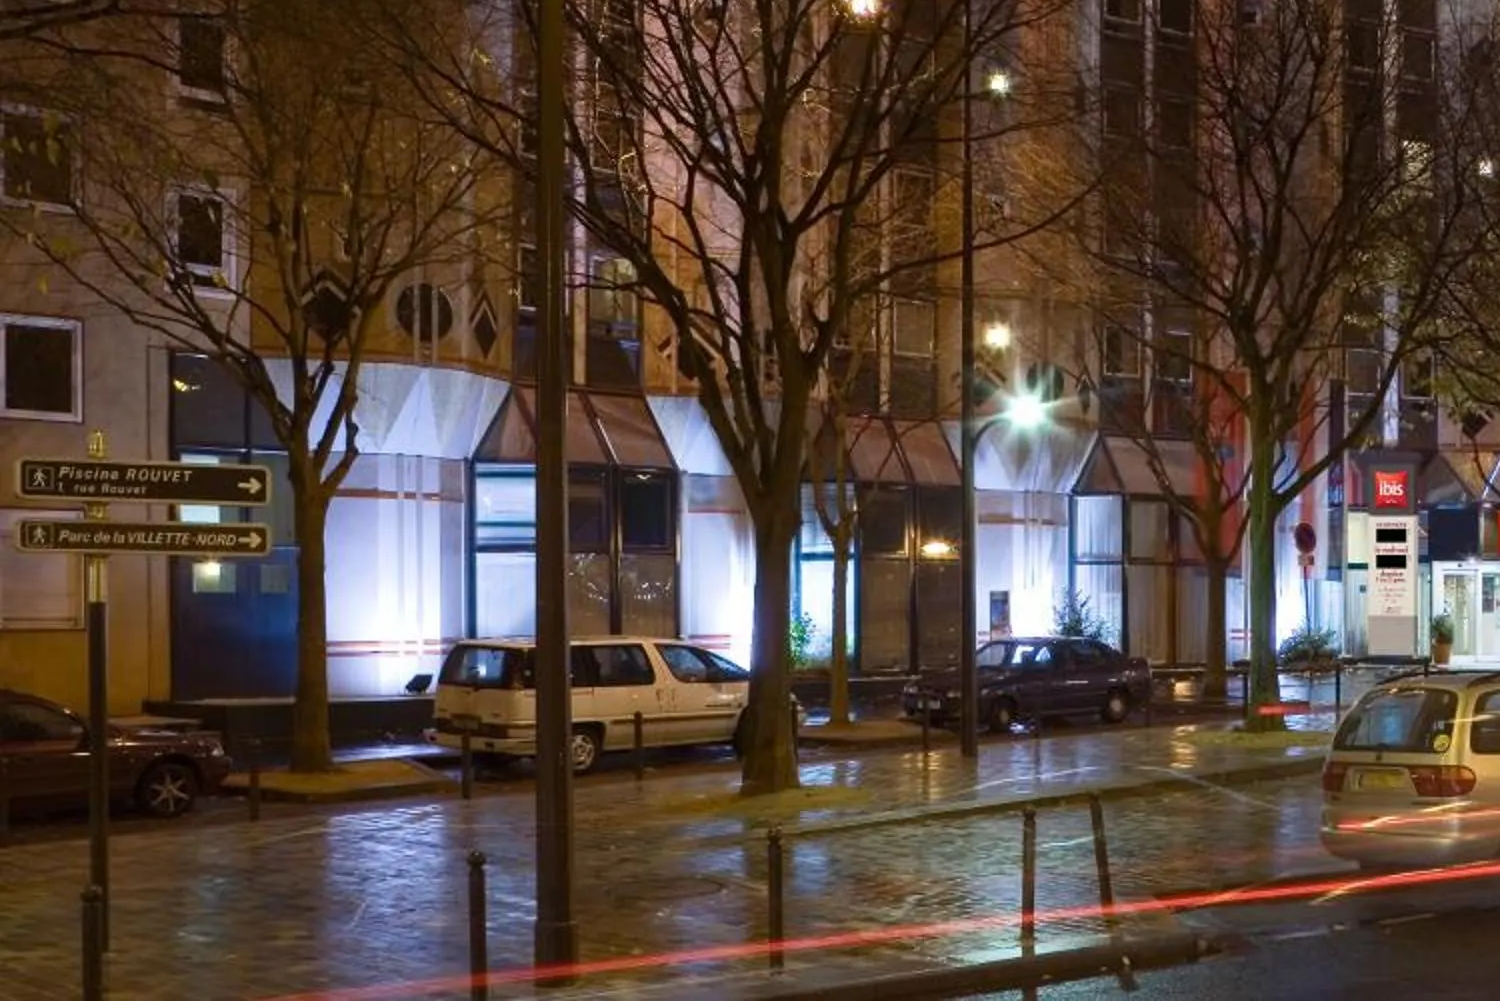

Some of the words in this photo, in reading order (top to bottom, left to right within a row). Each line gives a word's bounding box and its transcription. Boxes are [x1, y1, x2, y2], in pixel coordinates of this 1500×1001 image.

[58, 466, 120, 481] Piscine
[125, 468, 193, 482] ROUVET
[1379, 480, 1404, 496] ibis
[58, 529, 91, 544] Parc
[93, 531, 111, 544] de
[113, 531, 125, 544] la
[127, 532, 237, 547] VILLETTE-NORD
